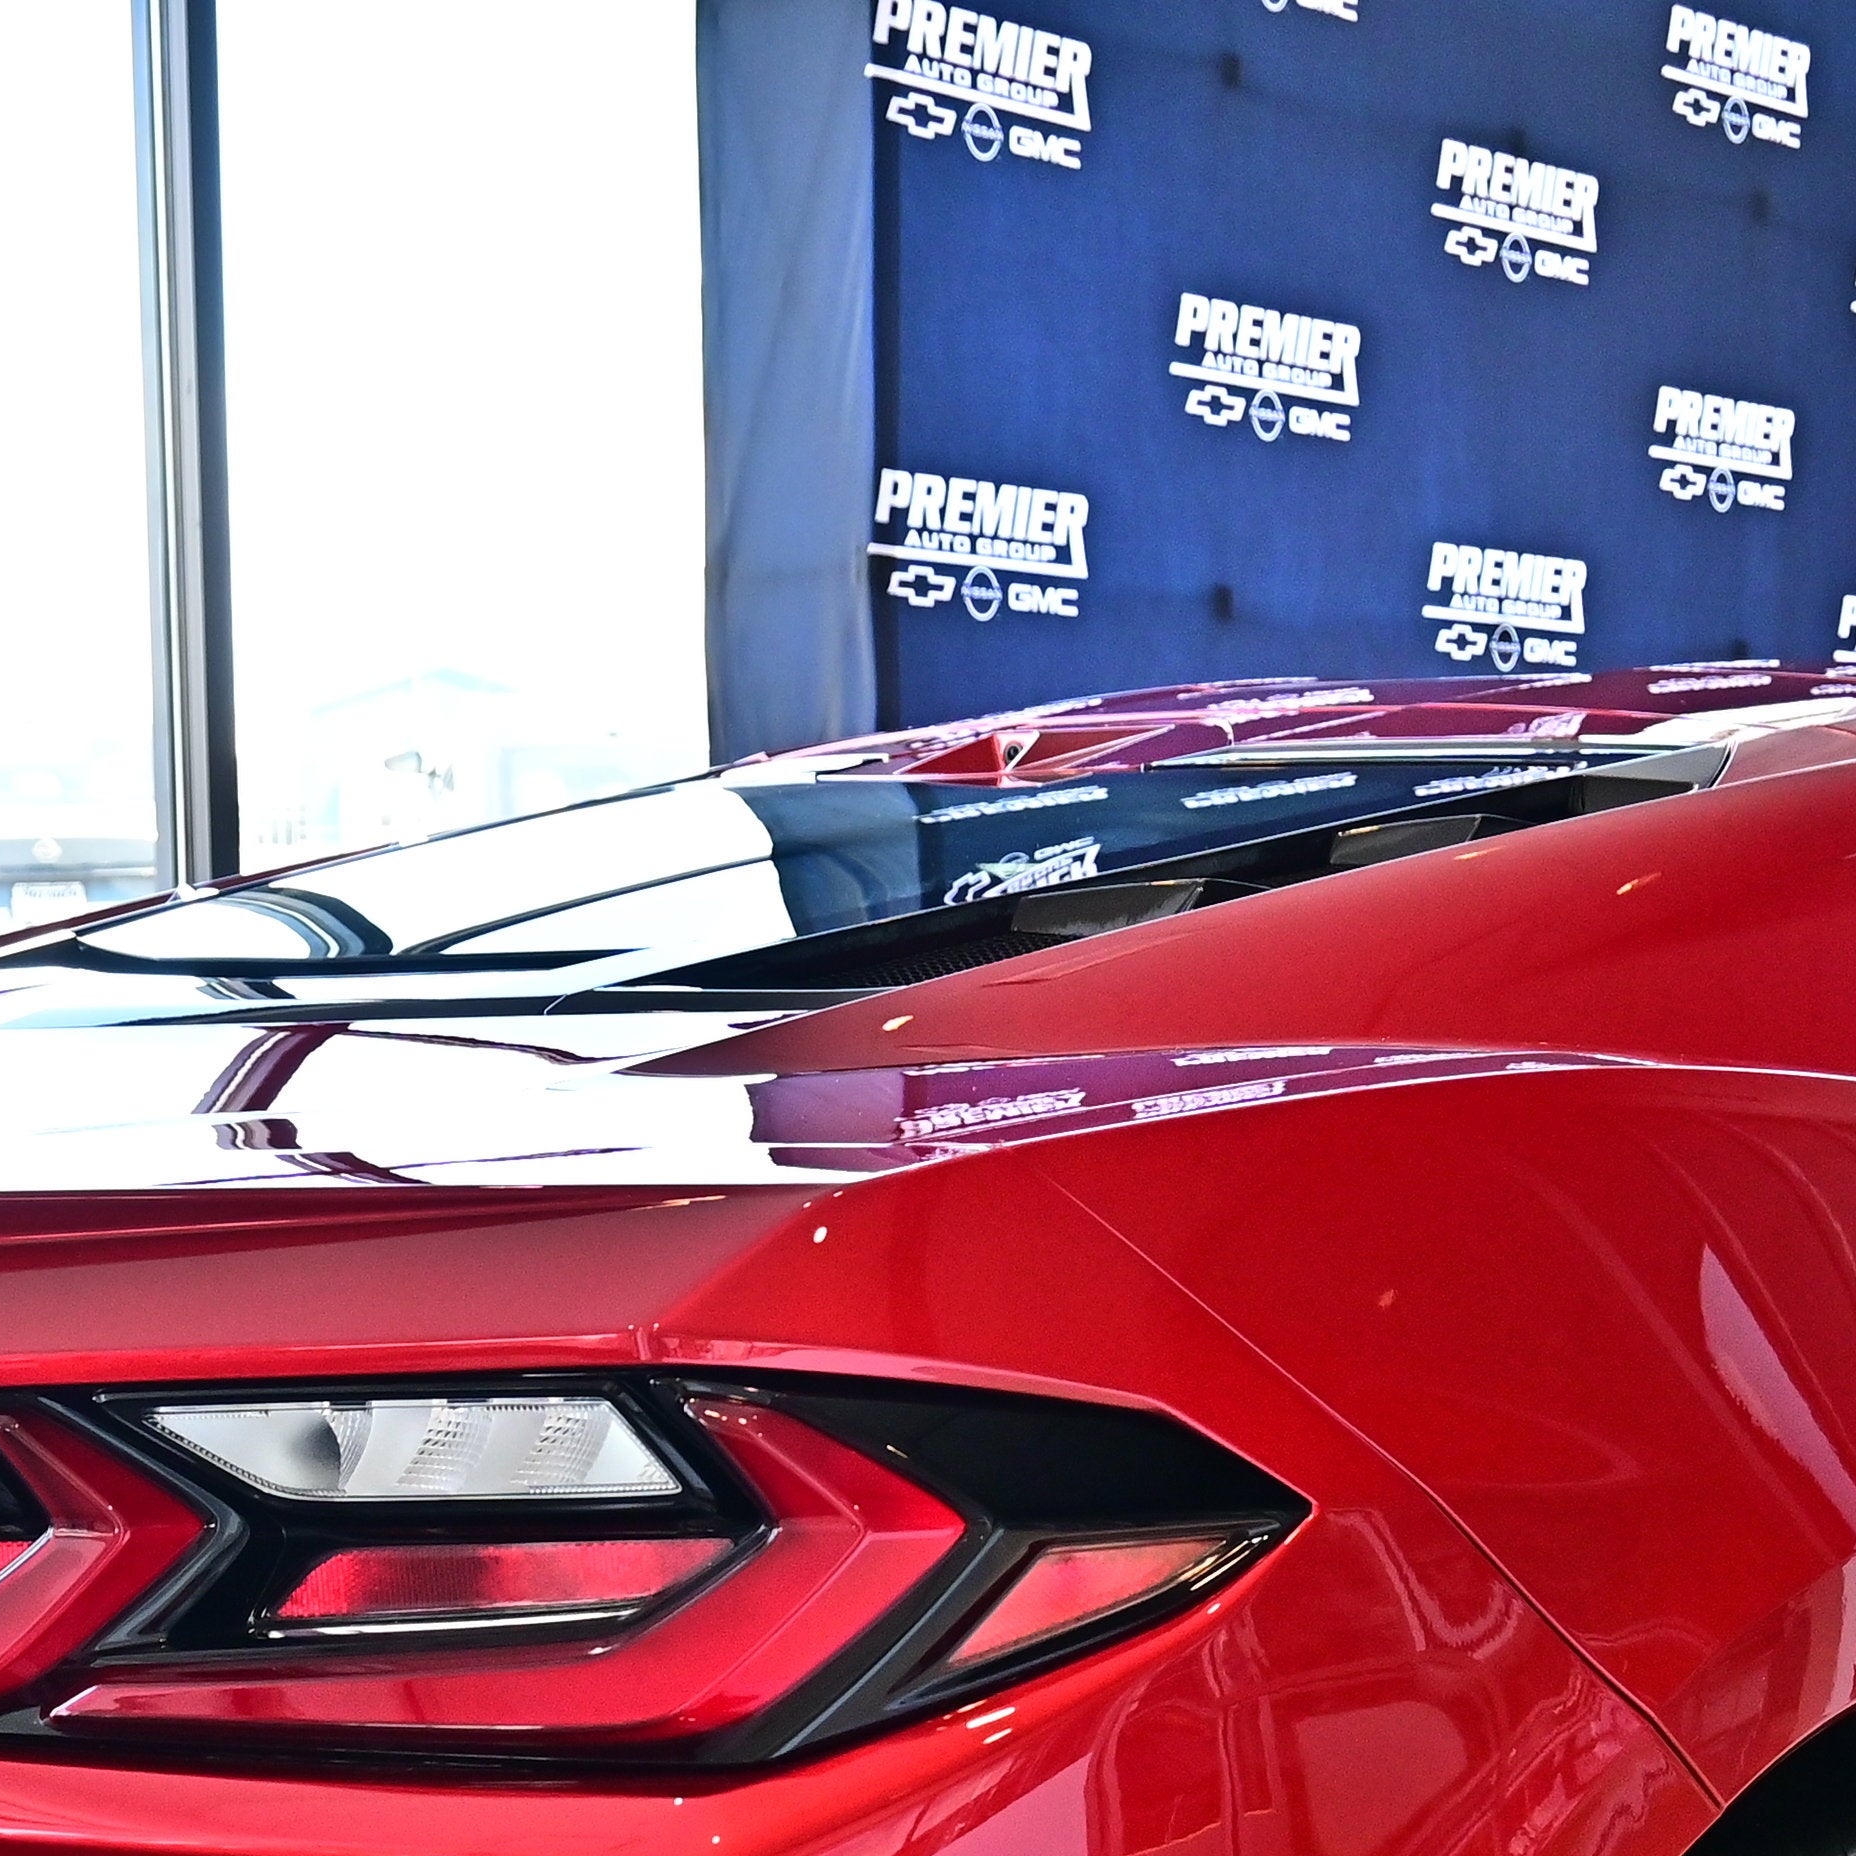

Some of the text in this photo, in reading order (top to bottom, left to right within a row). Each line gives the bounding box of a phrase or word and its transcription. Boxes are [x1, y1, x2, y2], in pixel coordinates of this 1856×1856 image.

[873, 0, 1092, 94] PREMIER
[1666, 4, 1811, 88] PREMIER
[904, 55, 1058, 108] AUTO GROUP
[1009, 125, 1081, 169] GMC
[1436, 138, 1599, 221] PREMIER
[1458, 194, 1574, 233] AUTO GROUP
[1175, 292, 1361, 374] PREMIER
[1201, 351, 1332, 387] AUTO GROUP
[1289, 406, 1351, 442] GMC
[1653, 385, 1795, 452] PREMIER
[875, 468, 1089, 546] PREMIER
[904, 529, 1056, 561] AUTO GROUP
[1008, 583, 1079, 617] GMC
[1427, 542, 1587, 606] PREMIER
[1450, 593, 1562, 619] AUTO GROUP
